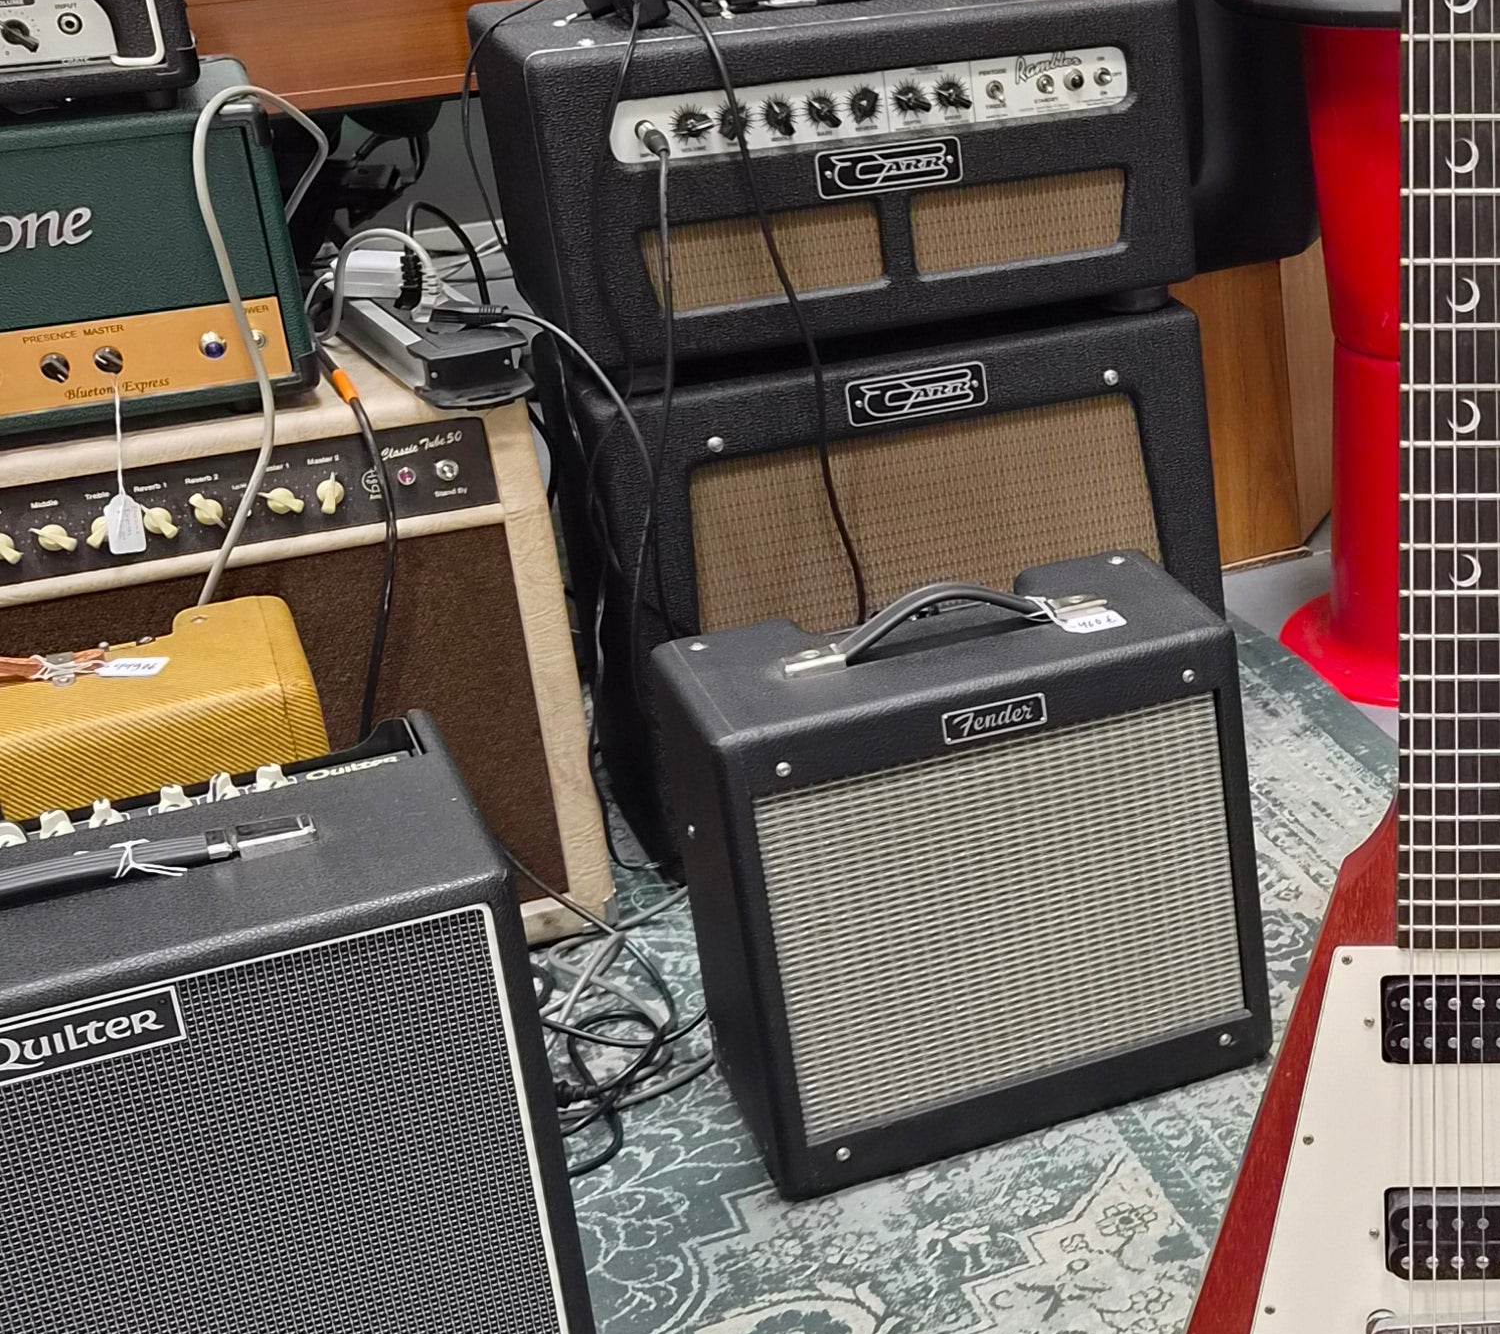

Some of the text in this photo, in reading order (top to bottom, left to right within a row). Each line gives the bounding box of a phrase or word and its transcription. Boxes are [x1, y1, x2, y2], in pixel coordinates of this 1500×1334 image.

[1015, 49, 1083, 85] Rambler
[22, 330, 78, 345] PRESENCE
[83, 323, 125, 337] MASTER
[121, 376, 171, 394] Express
[418, 435, 447, 452] Tube
[446, 430, 464, 444] 50
[83, 490, 111, 501] Treble
[132, 484, 162, 494] Reverb
[184, 475, 213, 485] Reverb
[952, 703, 1034, 737] Fender
